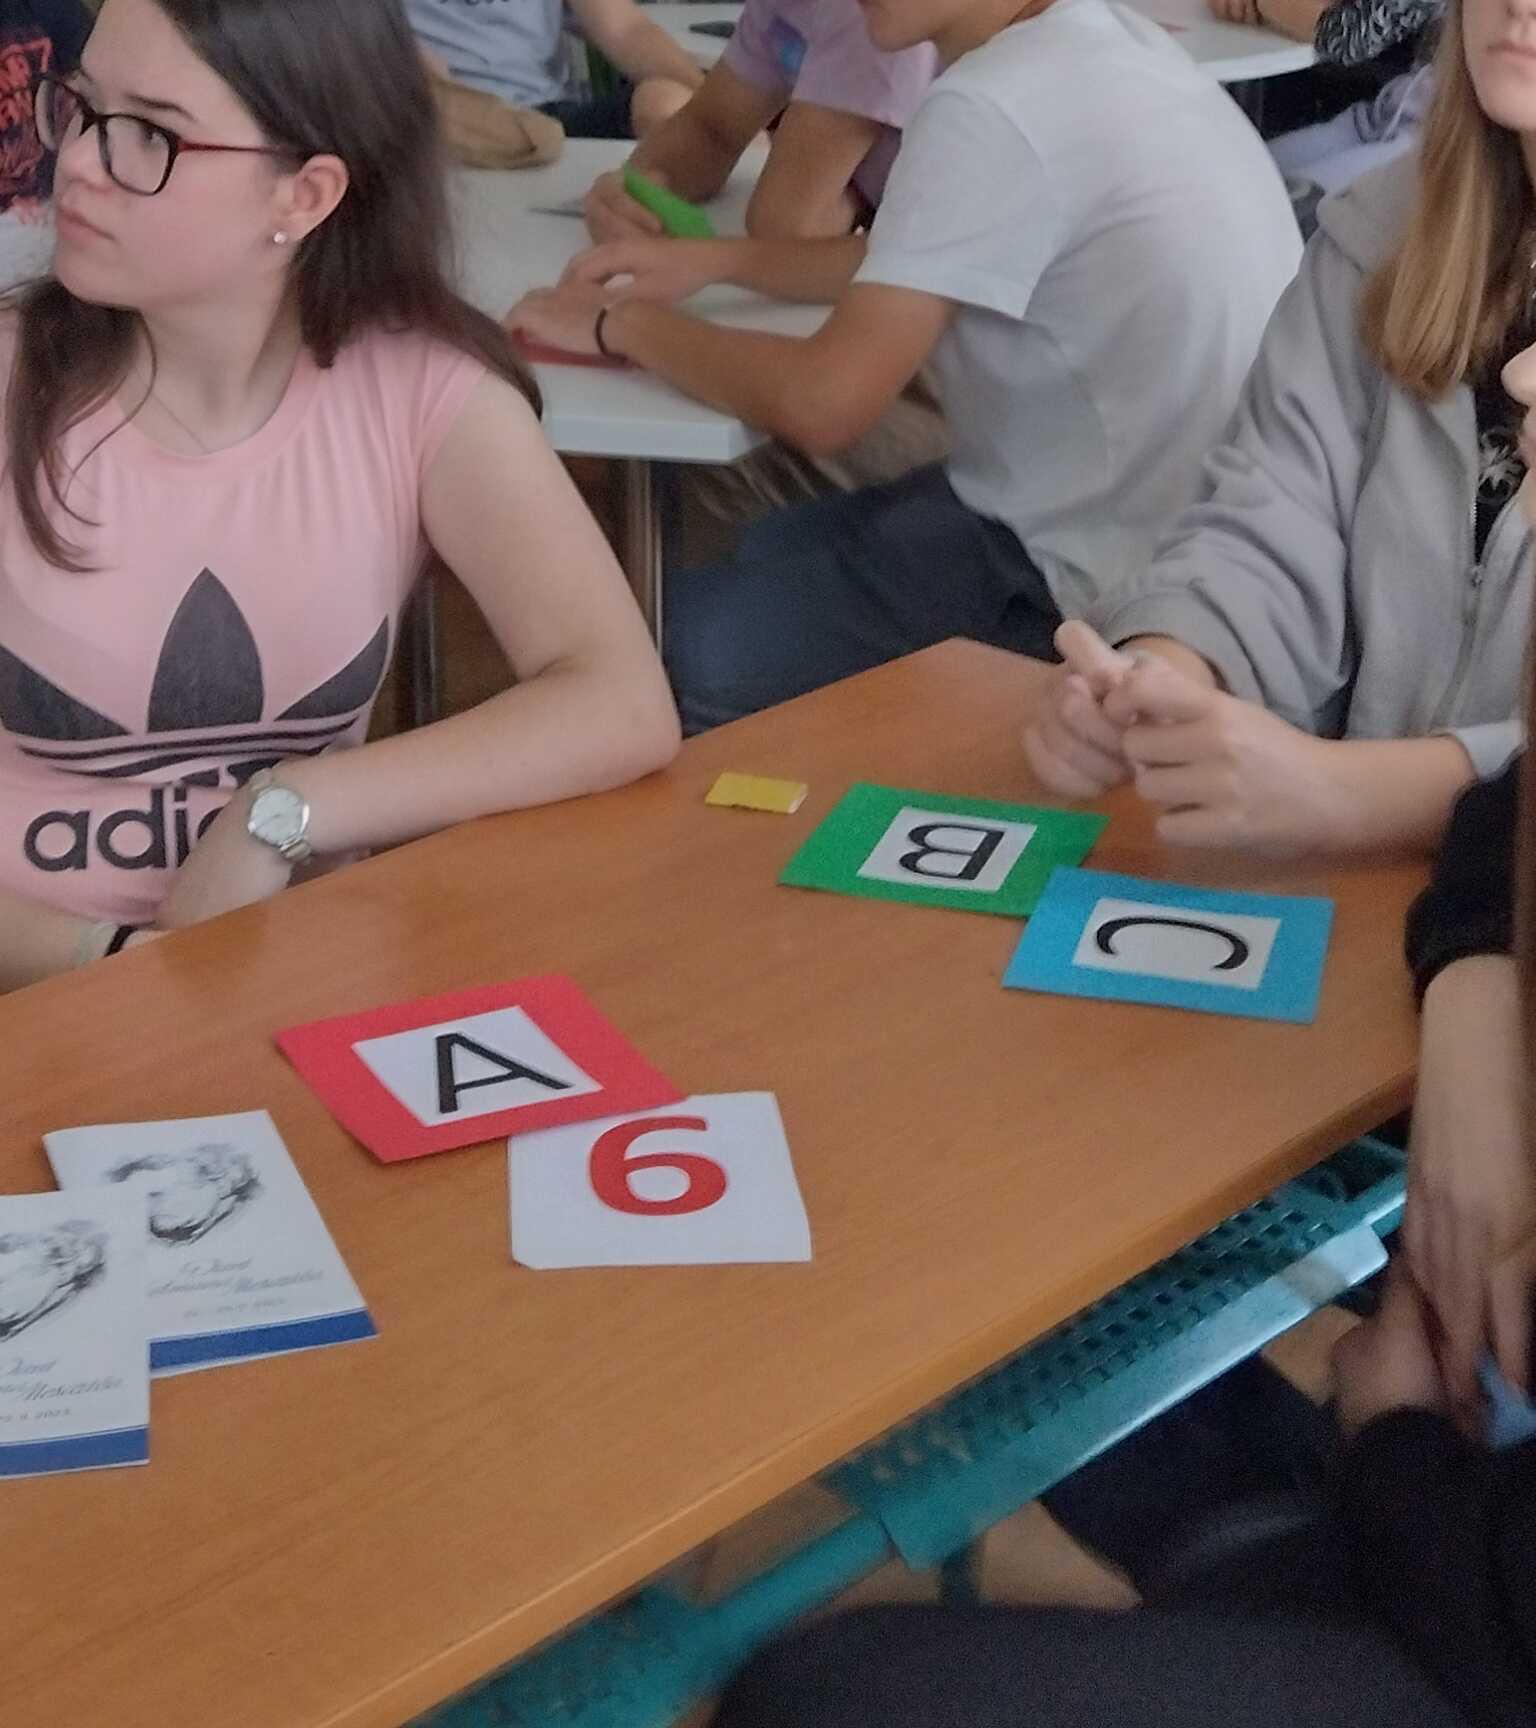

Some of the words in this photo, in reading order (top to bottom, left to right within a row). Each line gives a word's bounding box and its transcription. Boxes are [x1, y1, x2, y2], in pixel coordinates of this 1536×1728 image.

[23, 783, 226, 872] adi
[898, 823, 1005, 881] B
[1095, 915, 1250, 971] C
[435, 1032, 573, 1114] A
[588, 1115, 727, 1217] 6
